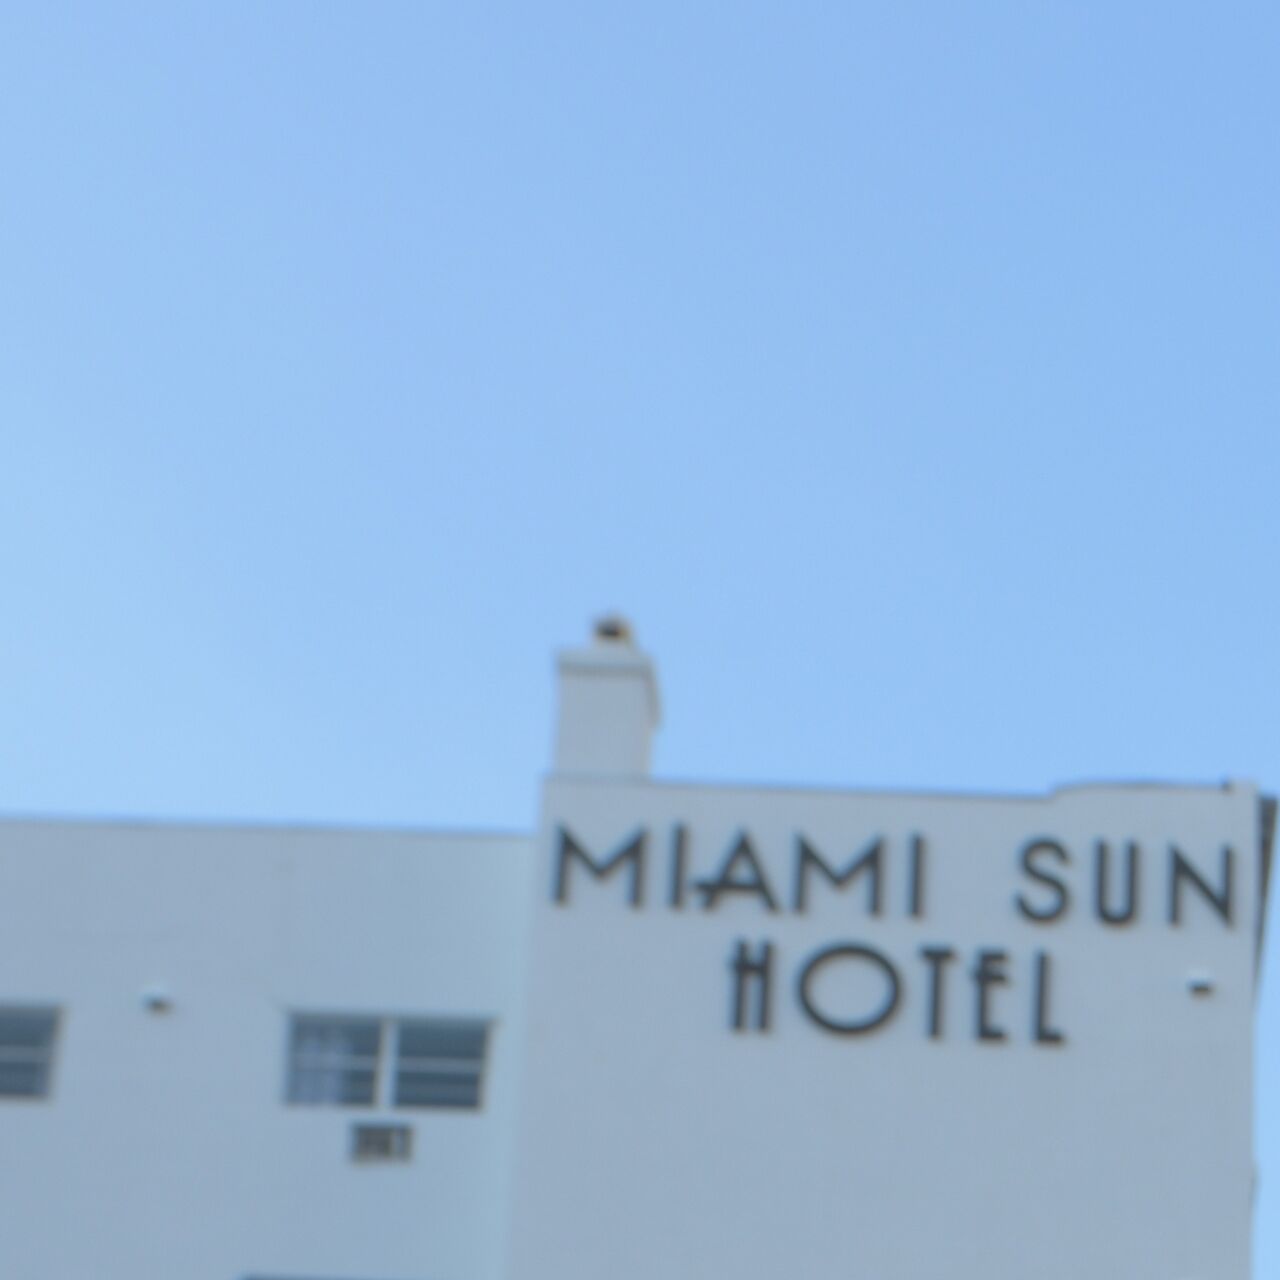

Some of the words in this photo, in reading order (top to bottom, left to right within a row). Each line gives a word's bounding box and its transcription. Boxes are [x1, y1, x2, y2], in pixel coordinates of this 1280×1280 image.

[553, 819, 926, 918] MIAMI
[1015, 837, 1237, 928] SUN
[726, 939, 1066, 1046] HOTEL
